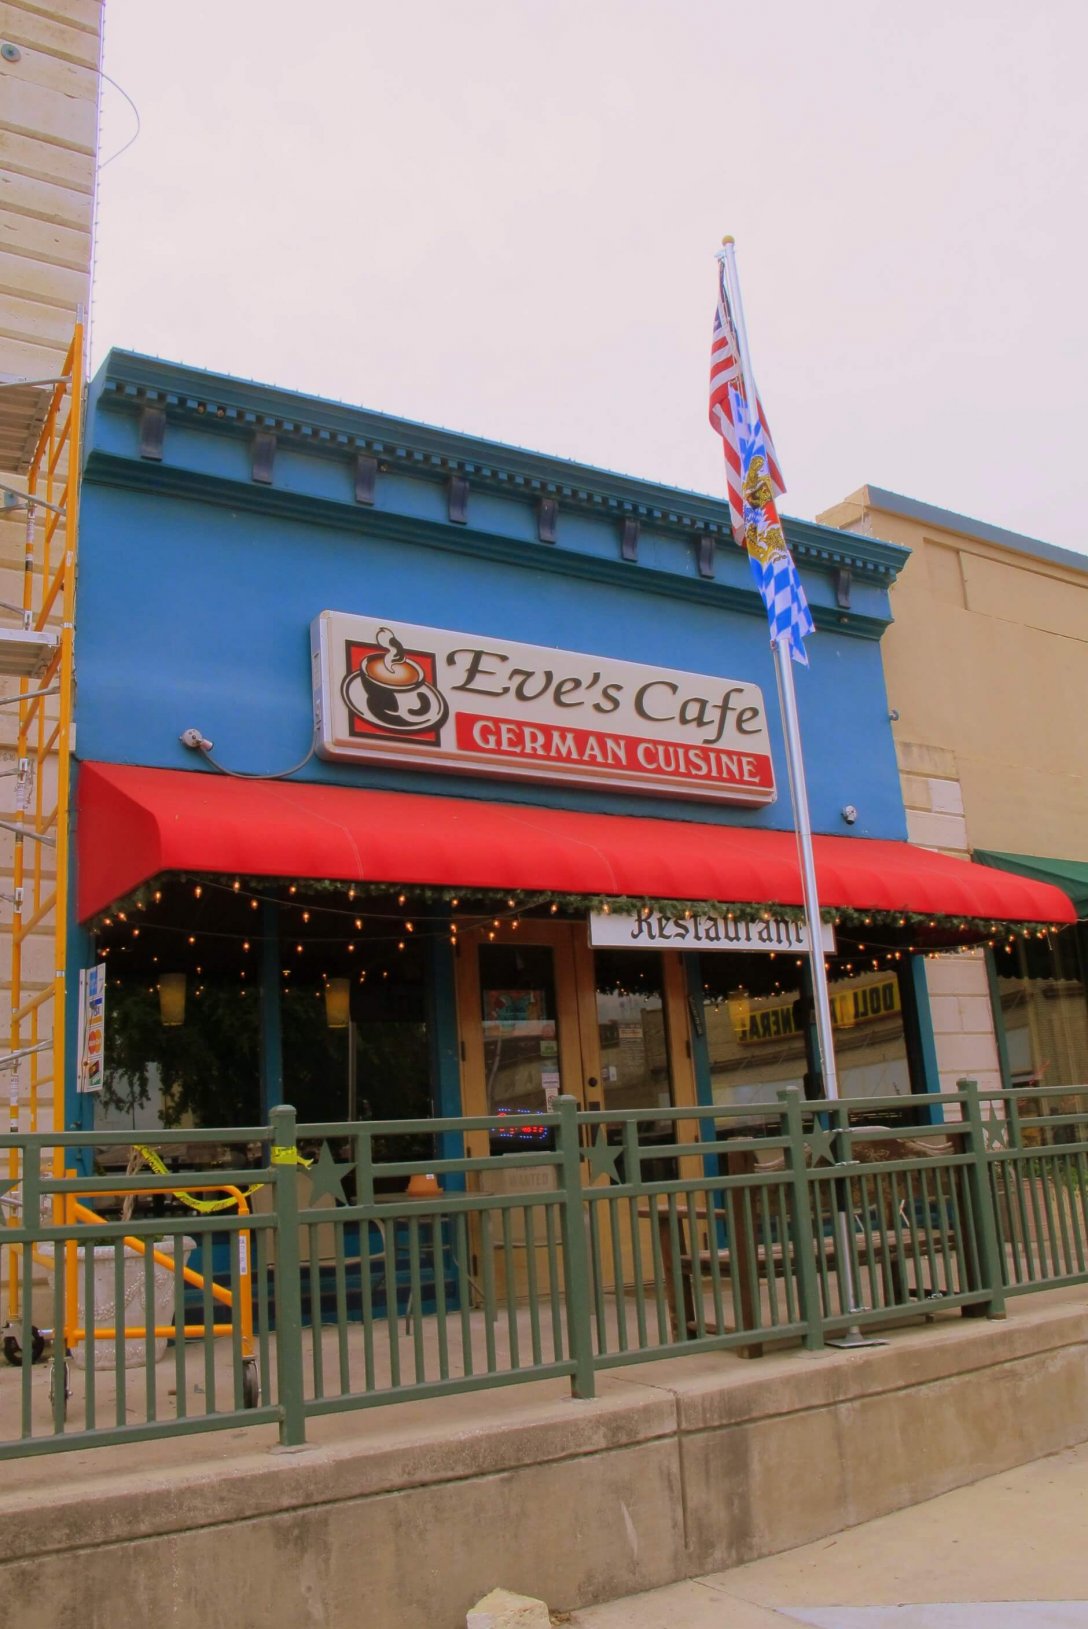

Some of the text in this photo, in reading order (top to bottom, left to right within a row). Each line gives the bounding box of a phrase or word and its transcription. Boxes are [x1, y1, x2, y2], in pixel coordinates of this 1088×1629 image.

[446, 647, 763, 744] Eve's Cafe
[472, 719, 761, 783] GERMAN CUISINE
[631, 907, 804, 949] Restaurant
